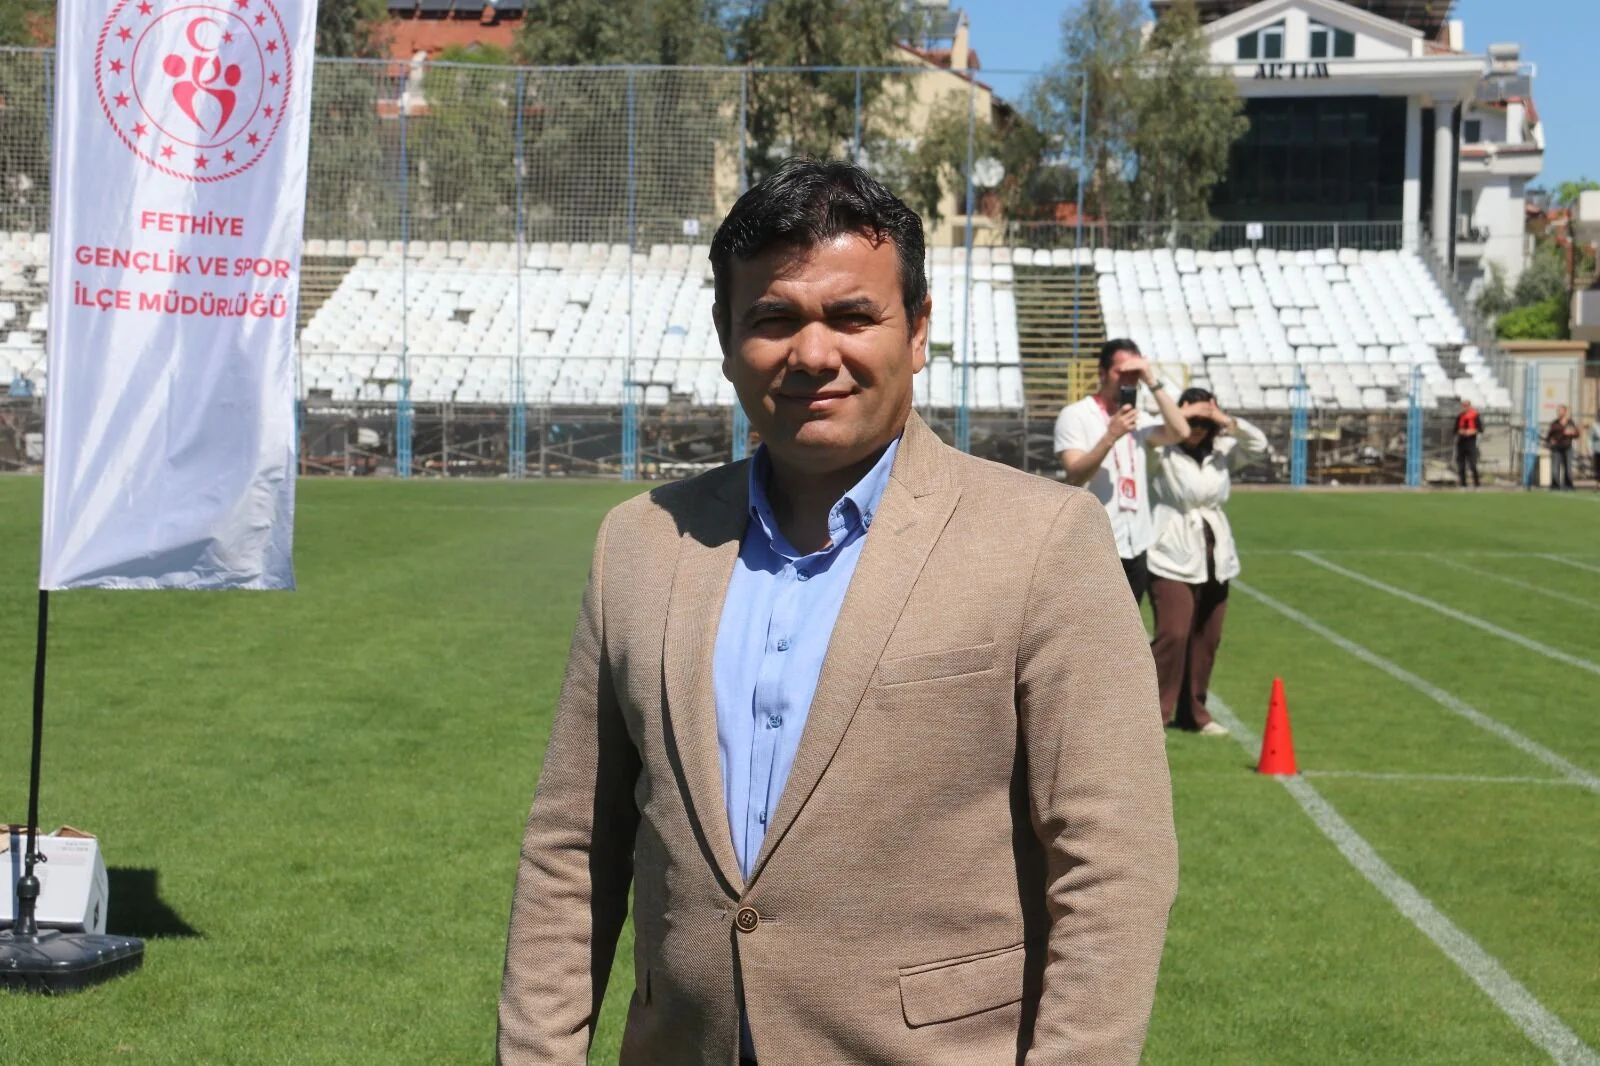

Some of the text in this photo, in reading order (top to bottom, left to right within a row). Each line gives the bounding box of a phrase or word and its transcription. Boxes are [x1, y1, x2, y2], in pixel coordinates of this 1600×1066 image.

[140, 210, 244, 237] FETHİYE
[75, 245, 290, 279] GENÇLİK VE SPOR
[74, 281, 287, 319] İLÇE MÜDÜRLÜĞÜ
